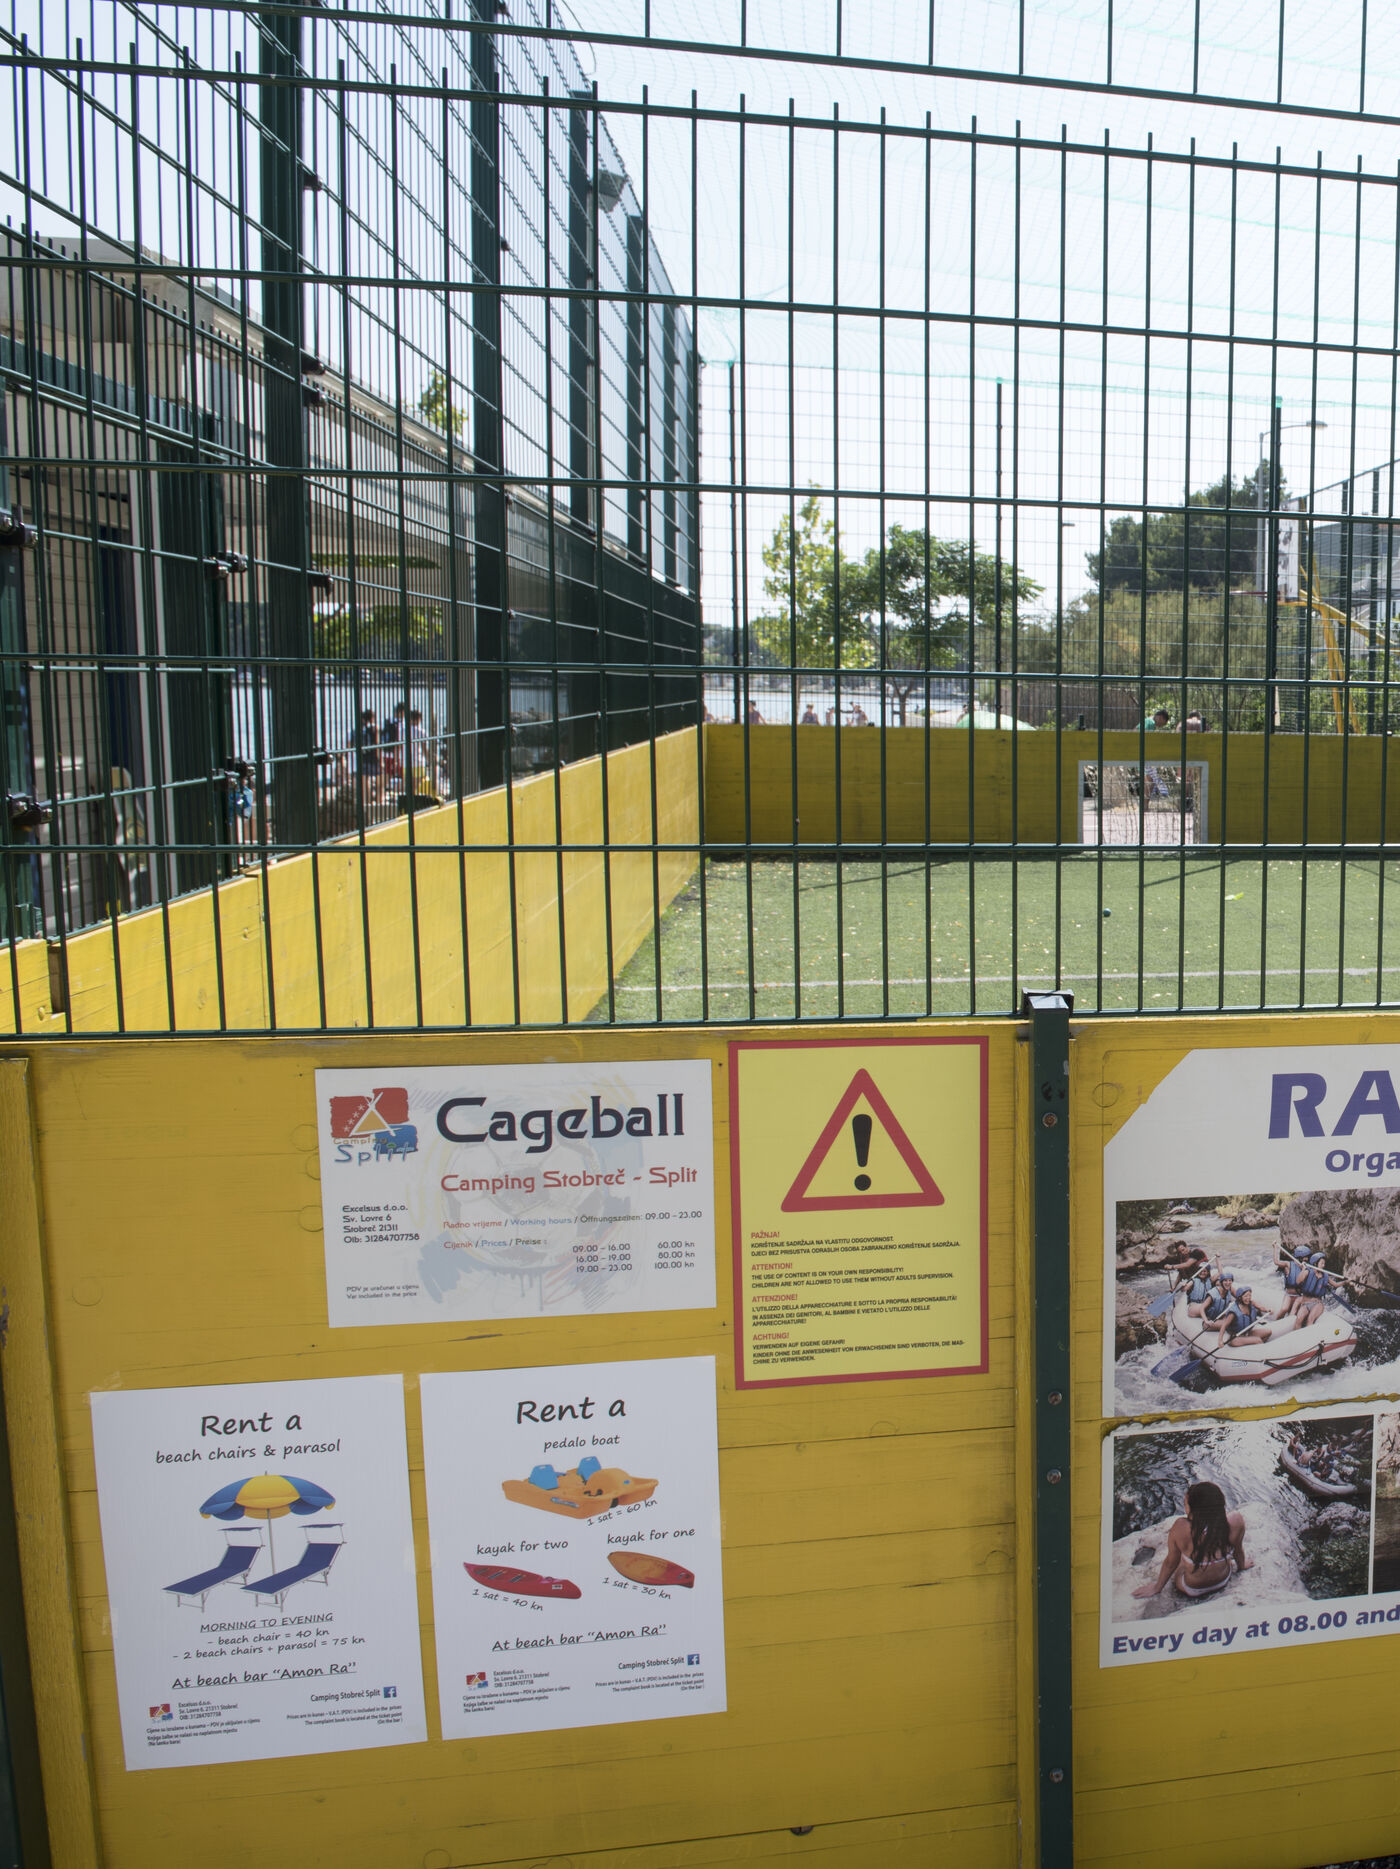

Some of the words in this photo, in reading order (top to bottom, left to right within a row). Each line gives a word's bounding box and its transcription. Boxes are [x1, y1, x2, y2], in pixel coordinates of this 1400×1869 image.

[436, 1093, 684, 1153] Cageball
[335, 1141, 415, 1166] Split
[441, 1175, 535, 1194] Camping
[543, 1169, 624, 1188] Stobreč
[650, 1167, 697, 1187] Split
[510, 1216, 546, 1226] Working
[645, 1212, 670, 1220] 09.00
[343, 1225, 376, 1233] Stobreč
[480, 1240, 507, 1248] Prices
[573, 1245, 598, 1253] 09.00
[608, 1243, 630, 1251] 16.00
[657, 1241, 682, 1249] 60.00
[576, 1255, 598, 1263] 16.00
[658, 1251, 683, 1259] 80.00
[608, 1264, 632, 1272] 23.00
[655, 1261, 682, 1269] 100.00
[517, 1397, 595, 1424] Rent
[609, 1400, 626, 1417] a
[201, 1412, 273, 1436] Rent
[286, 1415, 302, 1430] a
[156, 1449, 201, 1463] beach
[208, 1446, 256, 1460] chairs
[264, 1445, 275, 1456] &
[283, 1439, 340, 1459] parasol
[544, 1437, 586, 1452] pedalo
[592, 1435, 620, 1445] boat
[598, 1512, 612, 1523] sat
[627, 1504, 640, 1513] 60
[642, 1498, 658, 1509] kn
[607, 1531, 644, 1545] kayak
[650, 1530, 668, 1540] for
[674, 1529, 695, 1537] one
[477, 1542, 514, 1556] kayak
[520, 1541, 539, 1551] for
[544, 1541, 568, 1549] two
[613, 1581, 629, 1589] sat
[641, 1587, 656, 1595] 30
[659, 1590, 670, 1599] kn
[483, 1592, 498, 1600] sat
[531, 1601, 543, 1611] kn
[200, 1620, 256, 1633] MORNING
[261, 1619, 277, 1628] TO
[282, 1612, 333, 1626] EVENING
[1113, 1633, 1184, 1654] Every
[1192, 1627, 1237, 1646] day
[1246, 1621, 1269, 1638] at
[1278, 1611, 1347, 1634] 08.00
[1356, 1605, 1400, 1625] and
[218, 1635, 248, 1645] beach
[253, 1632, 280, 1642] chair
[296, 1630, 312, 1638] 40
[316, 1628, 329, 1636] kn
[492, 1640, 509, 1651] At
[516, 1636, 555, 1649] beach
[560, 1634, 584, 1645] bar
[196, 1648, 226, 1658] beach
[231, 1647, 263, 1655] chairs
[278, 1639, 316, 1654] parasol
[352, 1636, 365, 1644] kn
[618, 1661, 645, 1670] Camping
[671, 1657, 684, 1665] Split
[172, 1678, 191, 1689] At
[196, 1673, 237, 1687] beach
[243, 1670, 267, 1683] bar
[311, 1694, 339, 1702] Camping
[366, 1689, 380, 1698] Split
